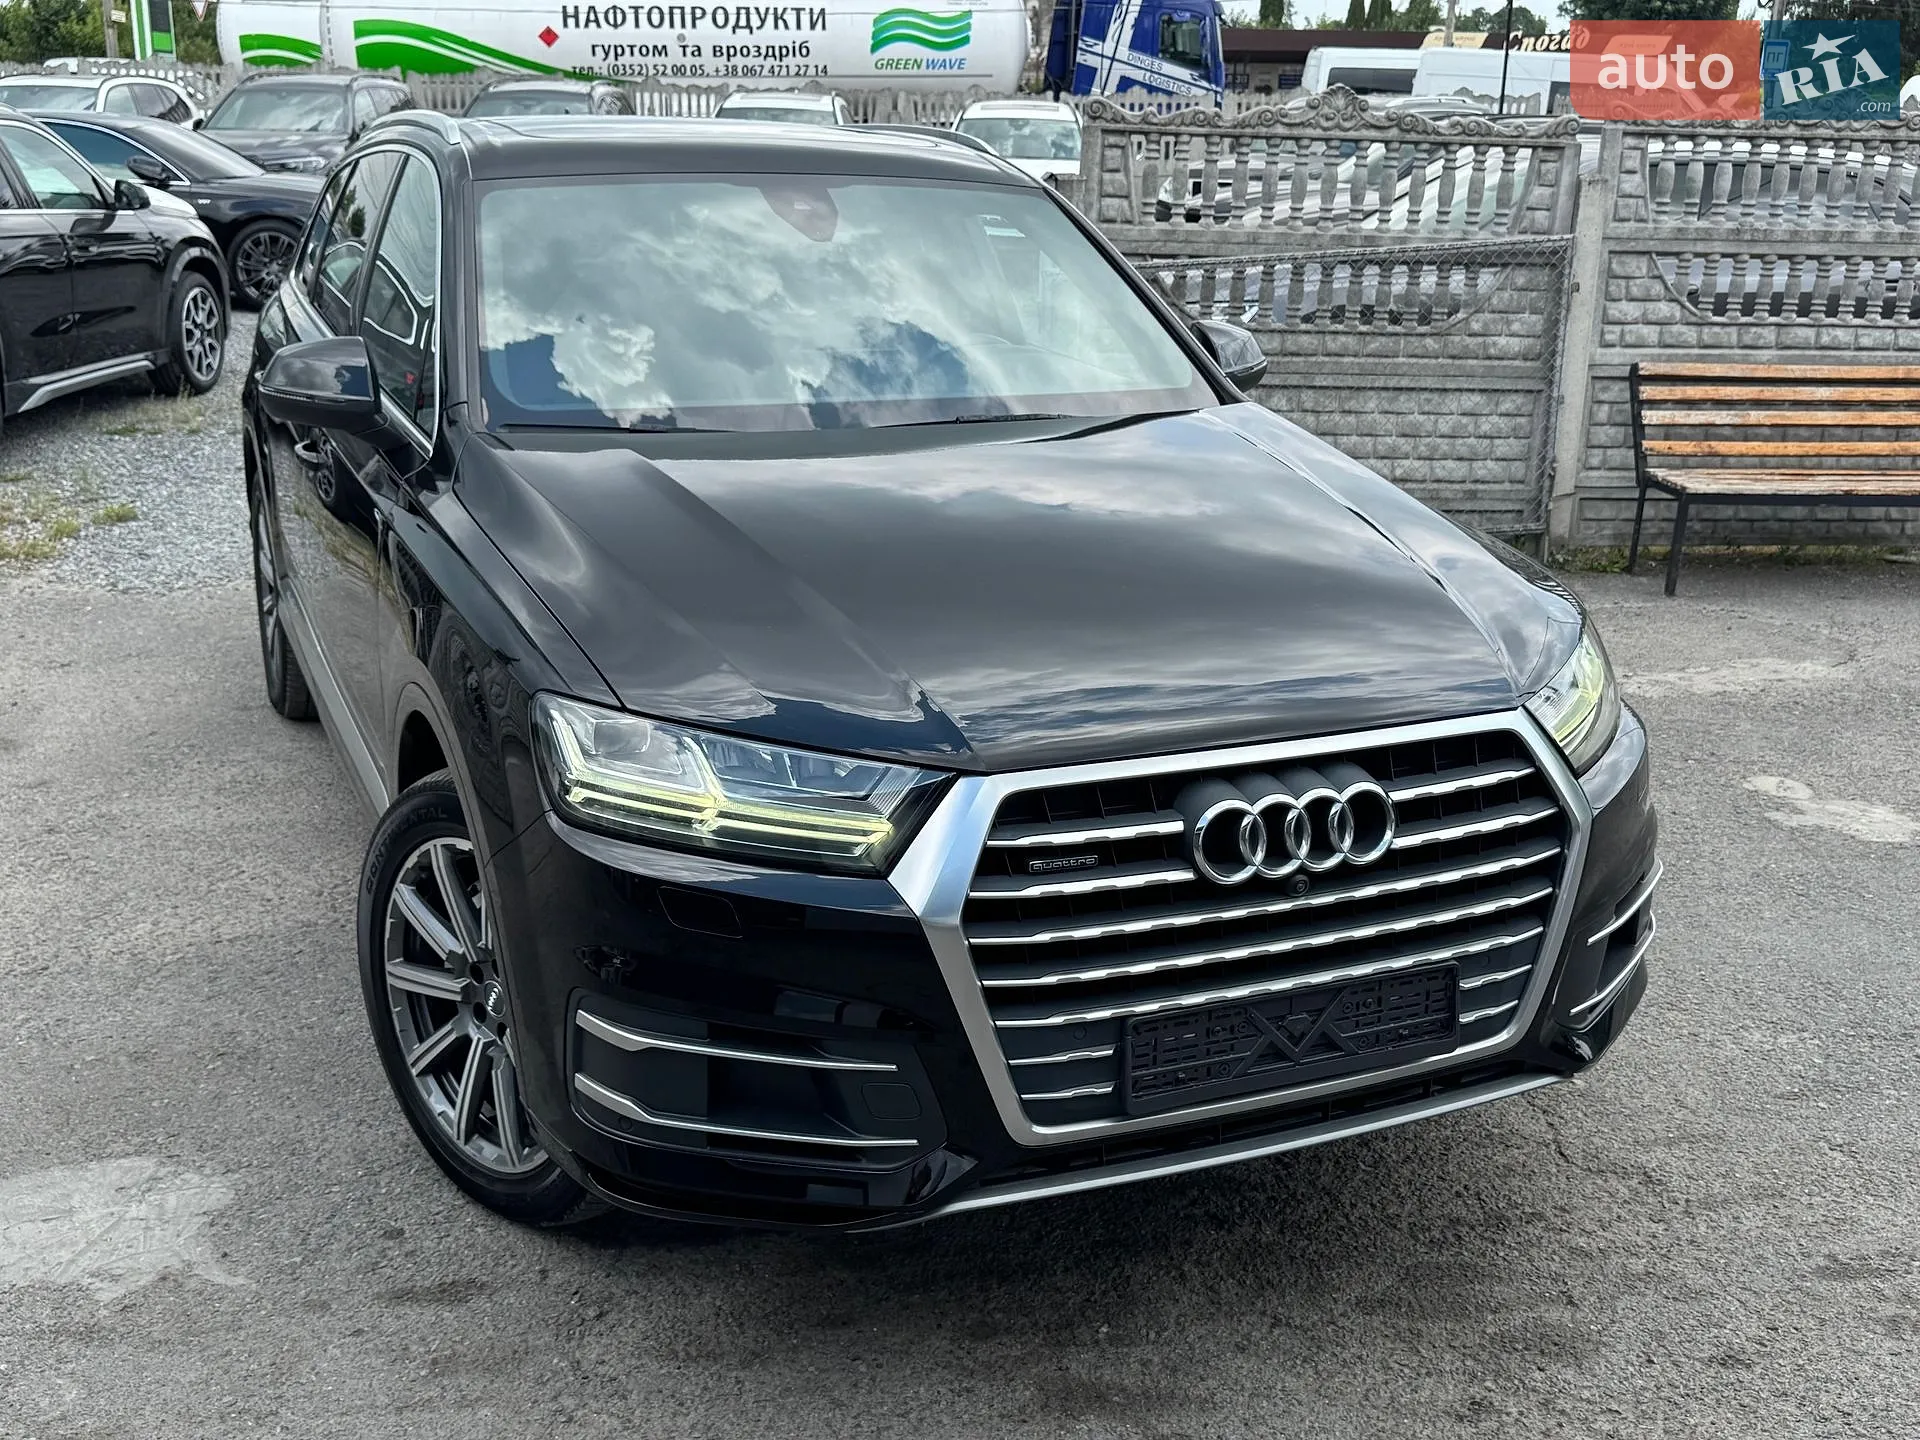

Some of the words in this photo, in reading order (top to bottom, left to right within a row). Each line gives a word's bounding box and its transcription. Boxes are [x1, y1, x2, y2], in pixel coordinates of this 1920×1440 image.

[562, 5, 827, 35] НАФТОПРОДУКТИ
[591, 44, 668, 61] гуртом
[679, 44, 703, 57] та
[712, 40, 810, 61] вроздріб
[572, 65, 602, 77] тел.:
[607, 64, 650, 78] (0352)
[653, 64, 668, 76] 52
[671, 64, 687, 76] 00
[690, 64, 710, 78] 05,
[714, 64, 738, 77] +38
[741, 64, 765, 77] 067
[768, 64, 790, 77] 471
[794, 64, 810, 77] 27
[814, 64, 828, 77] 14
[874, 58, 923, 70] GREEN
[925, 58, 967, 70] WAVE
[1127, 53, 1164, 72] DINGES
[1143, 72, 1193, 95] LOGISTICS
[1033, 858, 1096, 871] quattro
